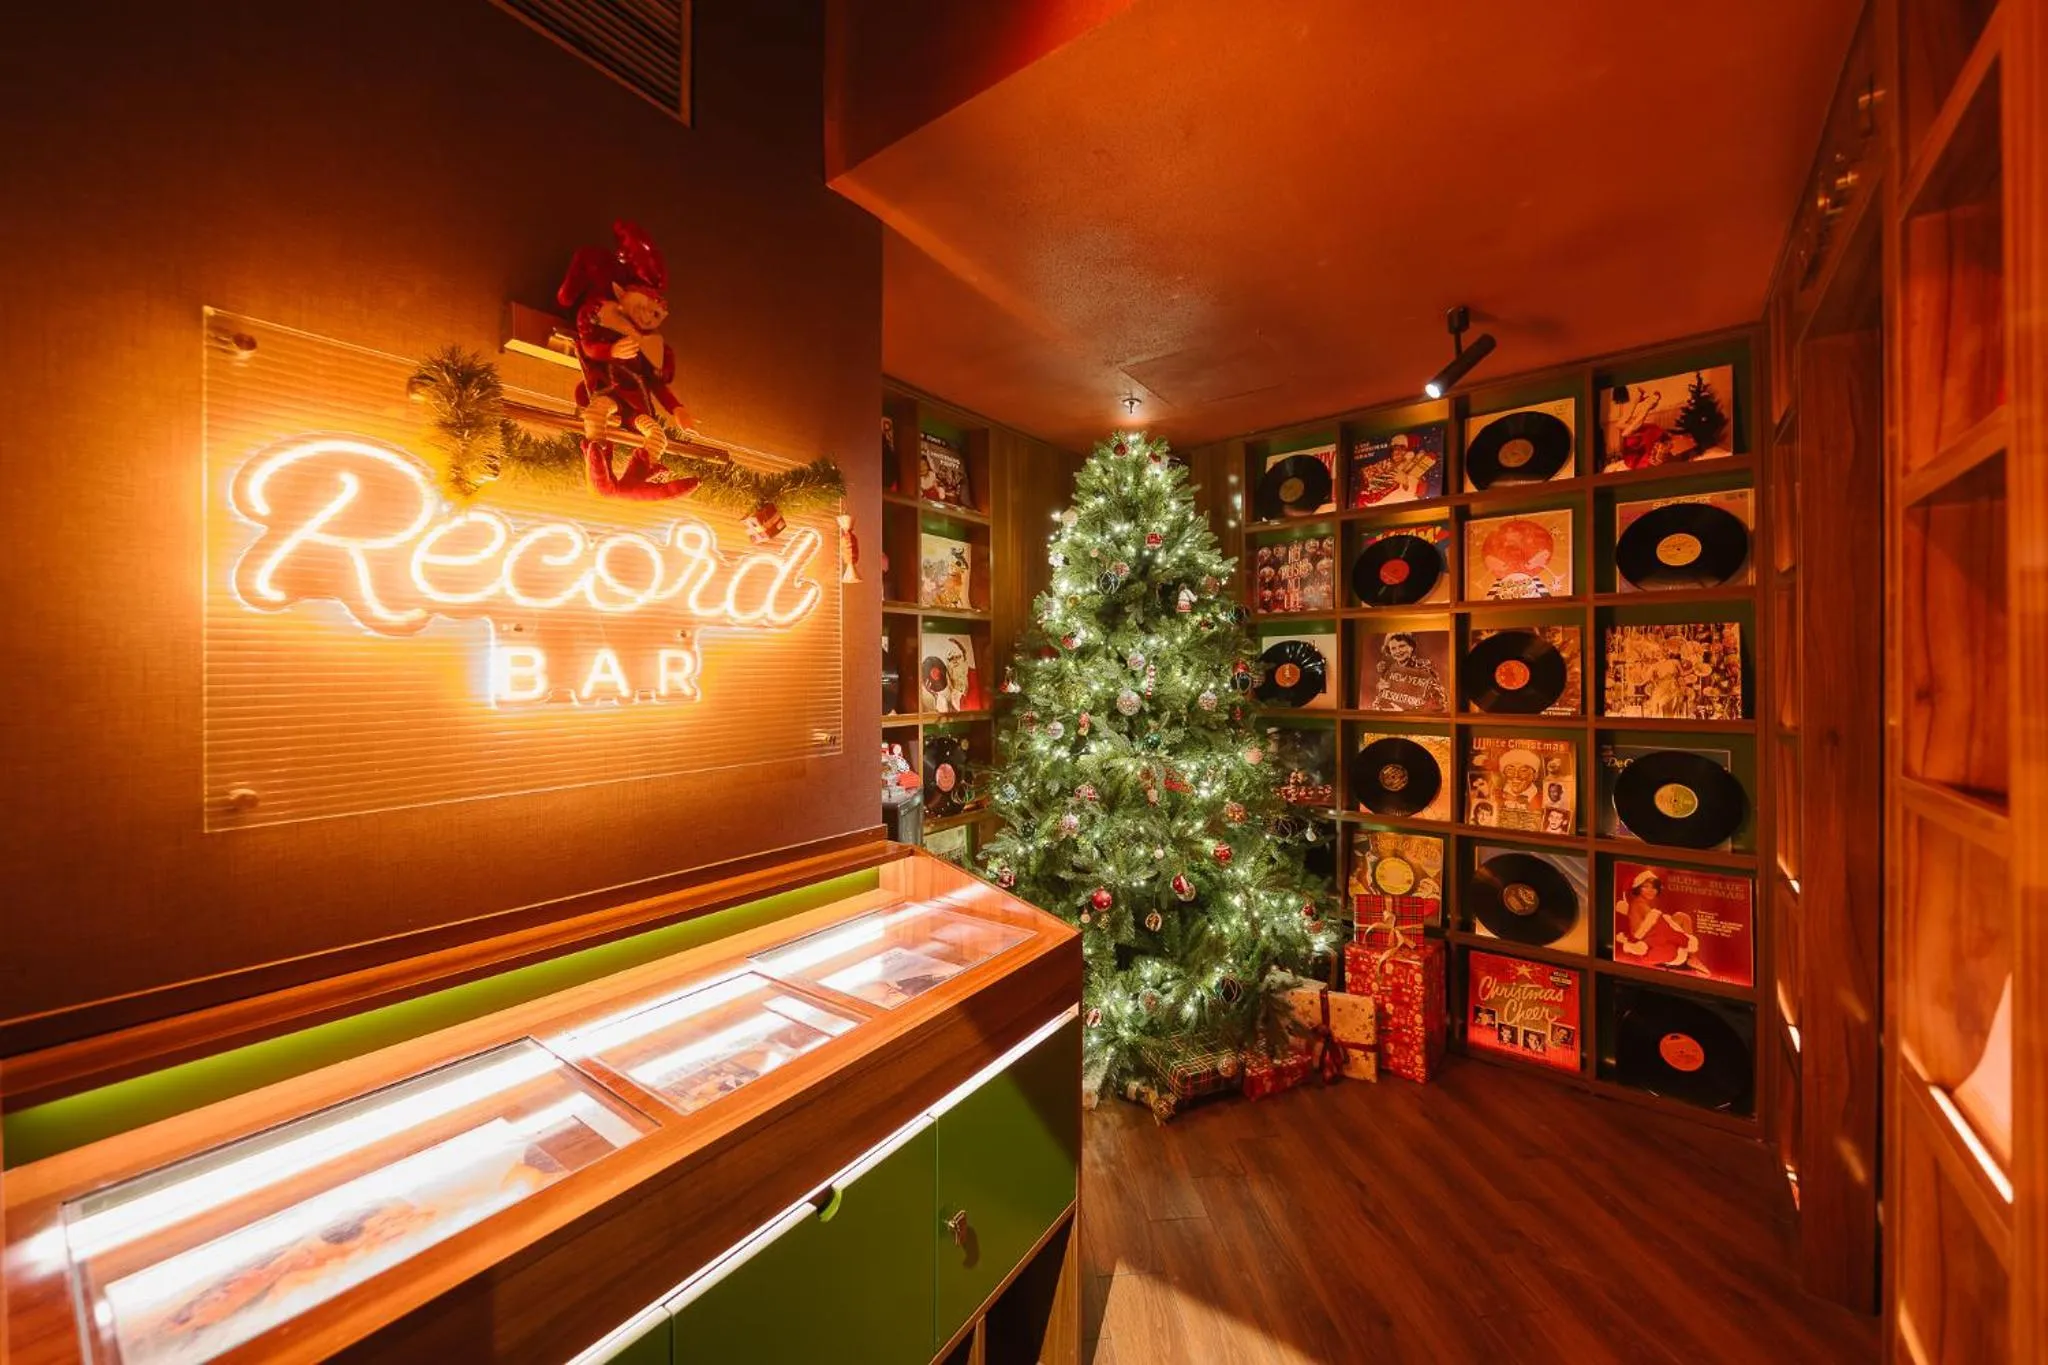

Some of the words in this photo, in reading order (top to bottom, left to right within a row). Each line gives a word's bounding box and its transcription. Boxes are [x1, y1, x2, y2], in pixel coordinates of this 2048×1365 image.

[248, 440, 820, 624] Record
[499, 644, 694, 700] BAR
[1508, 739, 1566, 753] Christmas
[1668, 884, 1746, 900] CHRISTMAS
[1479, 976, 1564, 1002] Christmas
[1504, 999, 1557, 1024] Cheer
